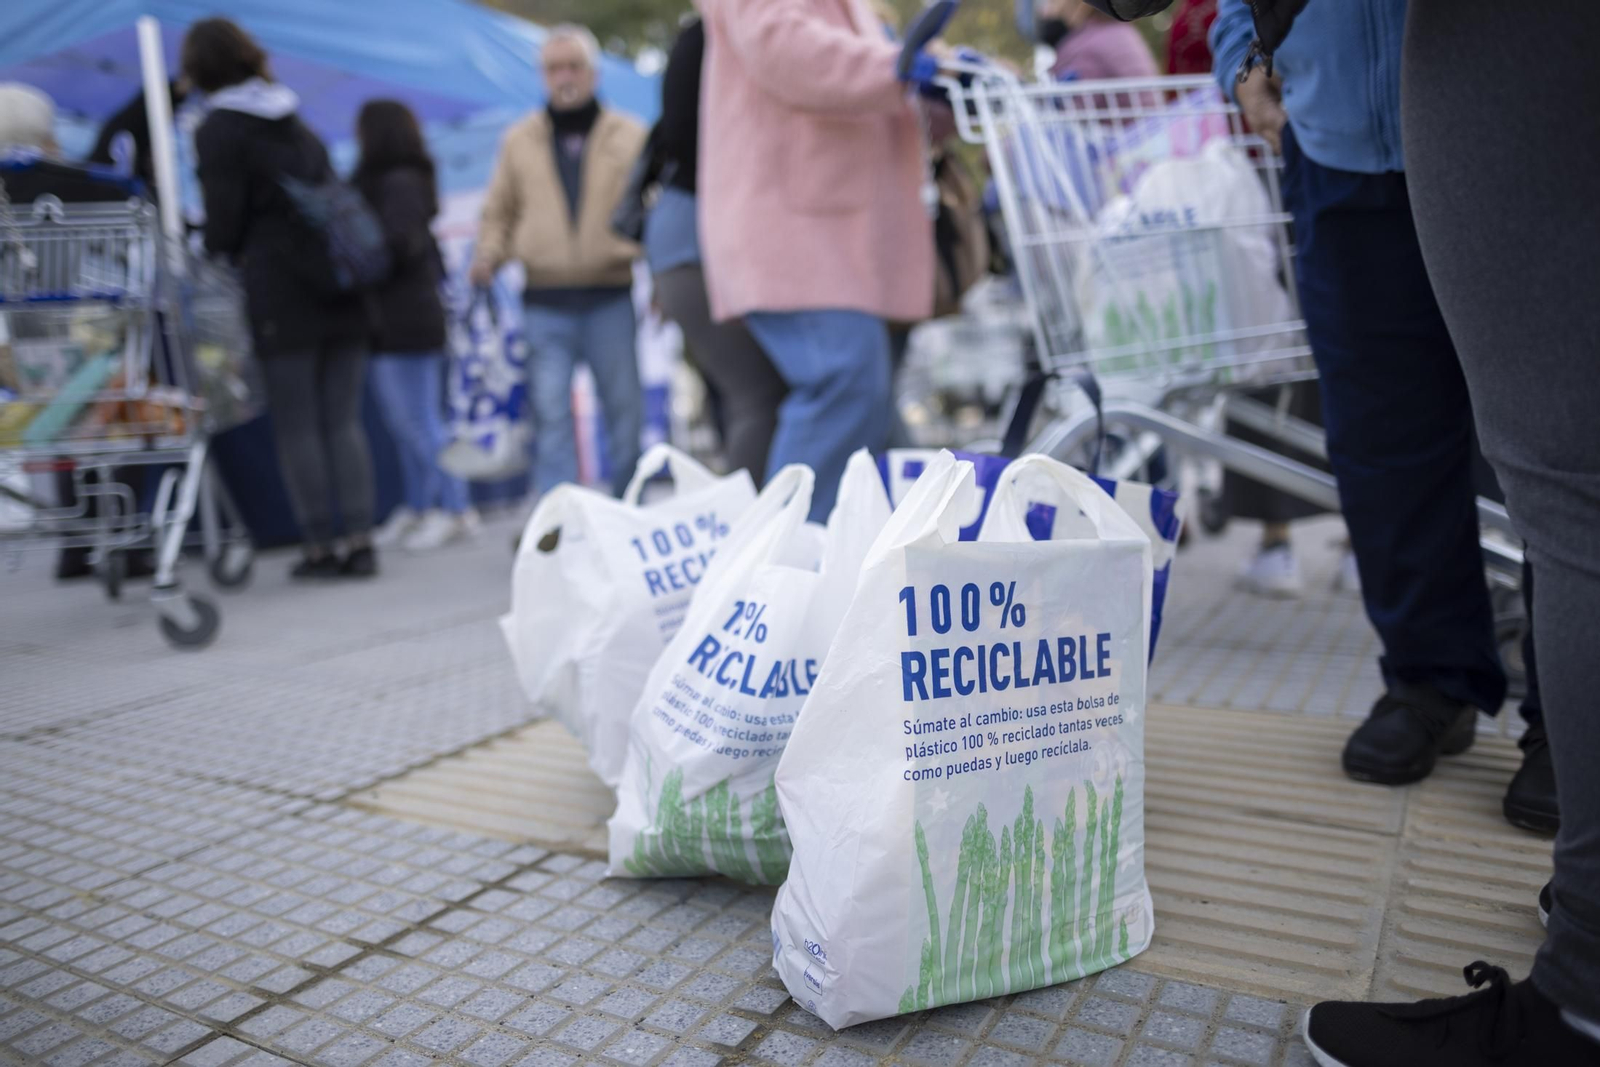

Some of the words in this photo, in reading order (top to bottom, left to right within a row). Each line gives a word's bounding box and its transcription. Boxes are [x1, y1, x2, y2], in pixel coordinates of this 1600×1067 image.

[631, 512, 731, 562] 100%
[899, 581, 1026, 636] 100%
[901, 632, 1112, 701] RECICLABLE
[771, 712, 794, 725] esta
[903, 718, 956, 735] Súmate
[960, 713, 972, 729] al
[975, 707, 1023, 726] cambio:
[1026, 704, 1047, 718] usa
[1050, 700, 1074, 715] esta
[1077, 696, 1105, 711] bolsa
[1107, 692, 1120, 706] de
[905, 740, 958, 761] plástico
[961, 733, 983, 751] 100
[987, 732, 999, 746] %
[1002, 724, 1056, 744] reciclado
[1058, 718, 1093, 735] tantas
[1095, 712, 1124, 728] veces
[903, 766, 943, 781] como
[946, 755, 992, 780] puedas
[995, 755, 1002, 771] y
[1005, 748, 1038, 766] luego
[1041, 739, 1092, 759] recíclala.
